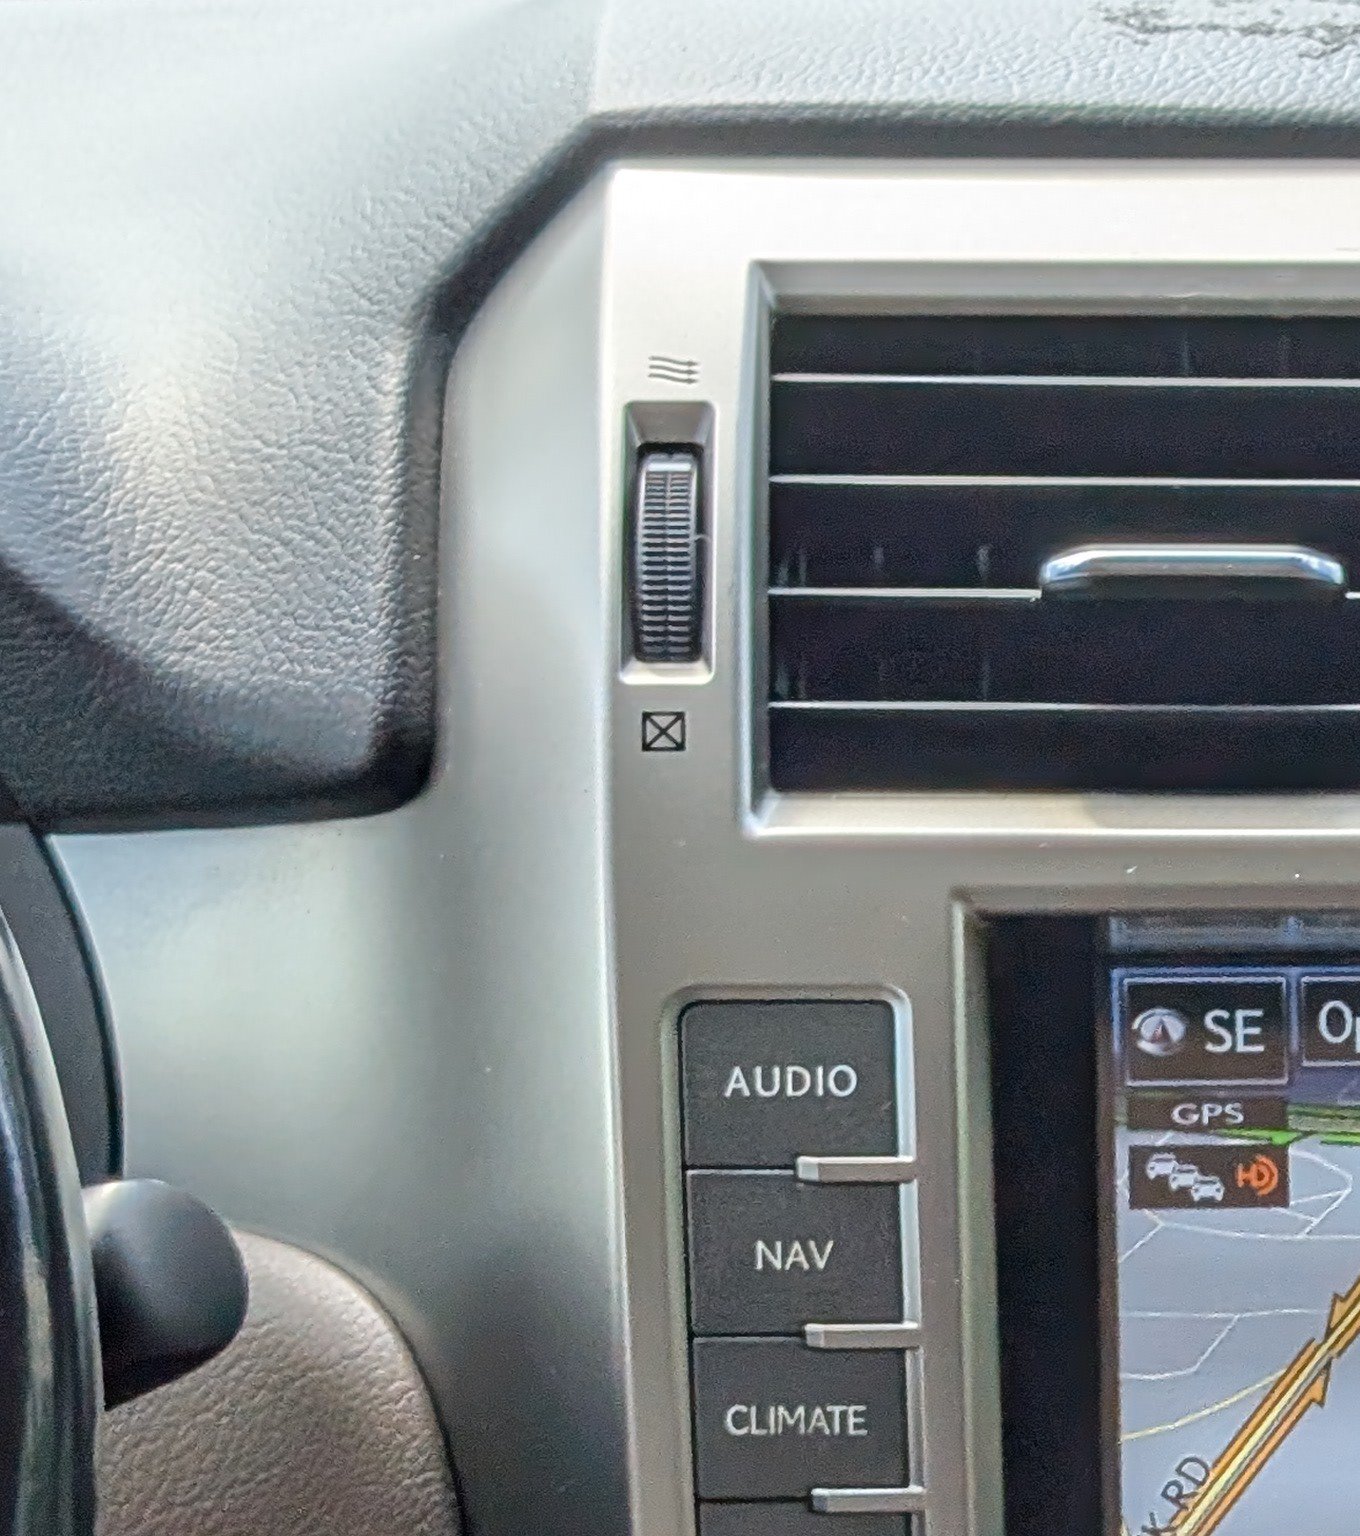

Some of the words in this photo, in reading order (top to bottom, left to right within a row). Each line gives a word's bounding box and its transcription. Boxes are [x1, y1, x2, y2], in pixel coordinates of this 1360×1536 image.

[1204, 1009, 1266, 1054] SE
[724, 1064, 858, 1098] AUDIO
[1171, 1102, 1244, 1126] GPS
[755, 1239, 834, 1271] NAV
[724, 1404, 868, 1436] CLIMATE
[1160, 1456, 1211, 1512] RD
